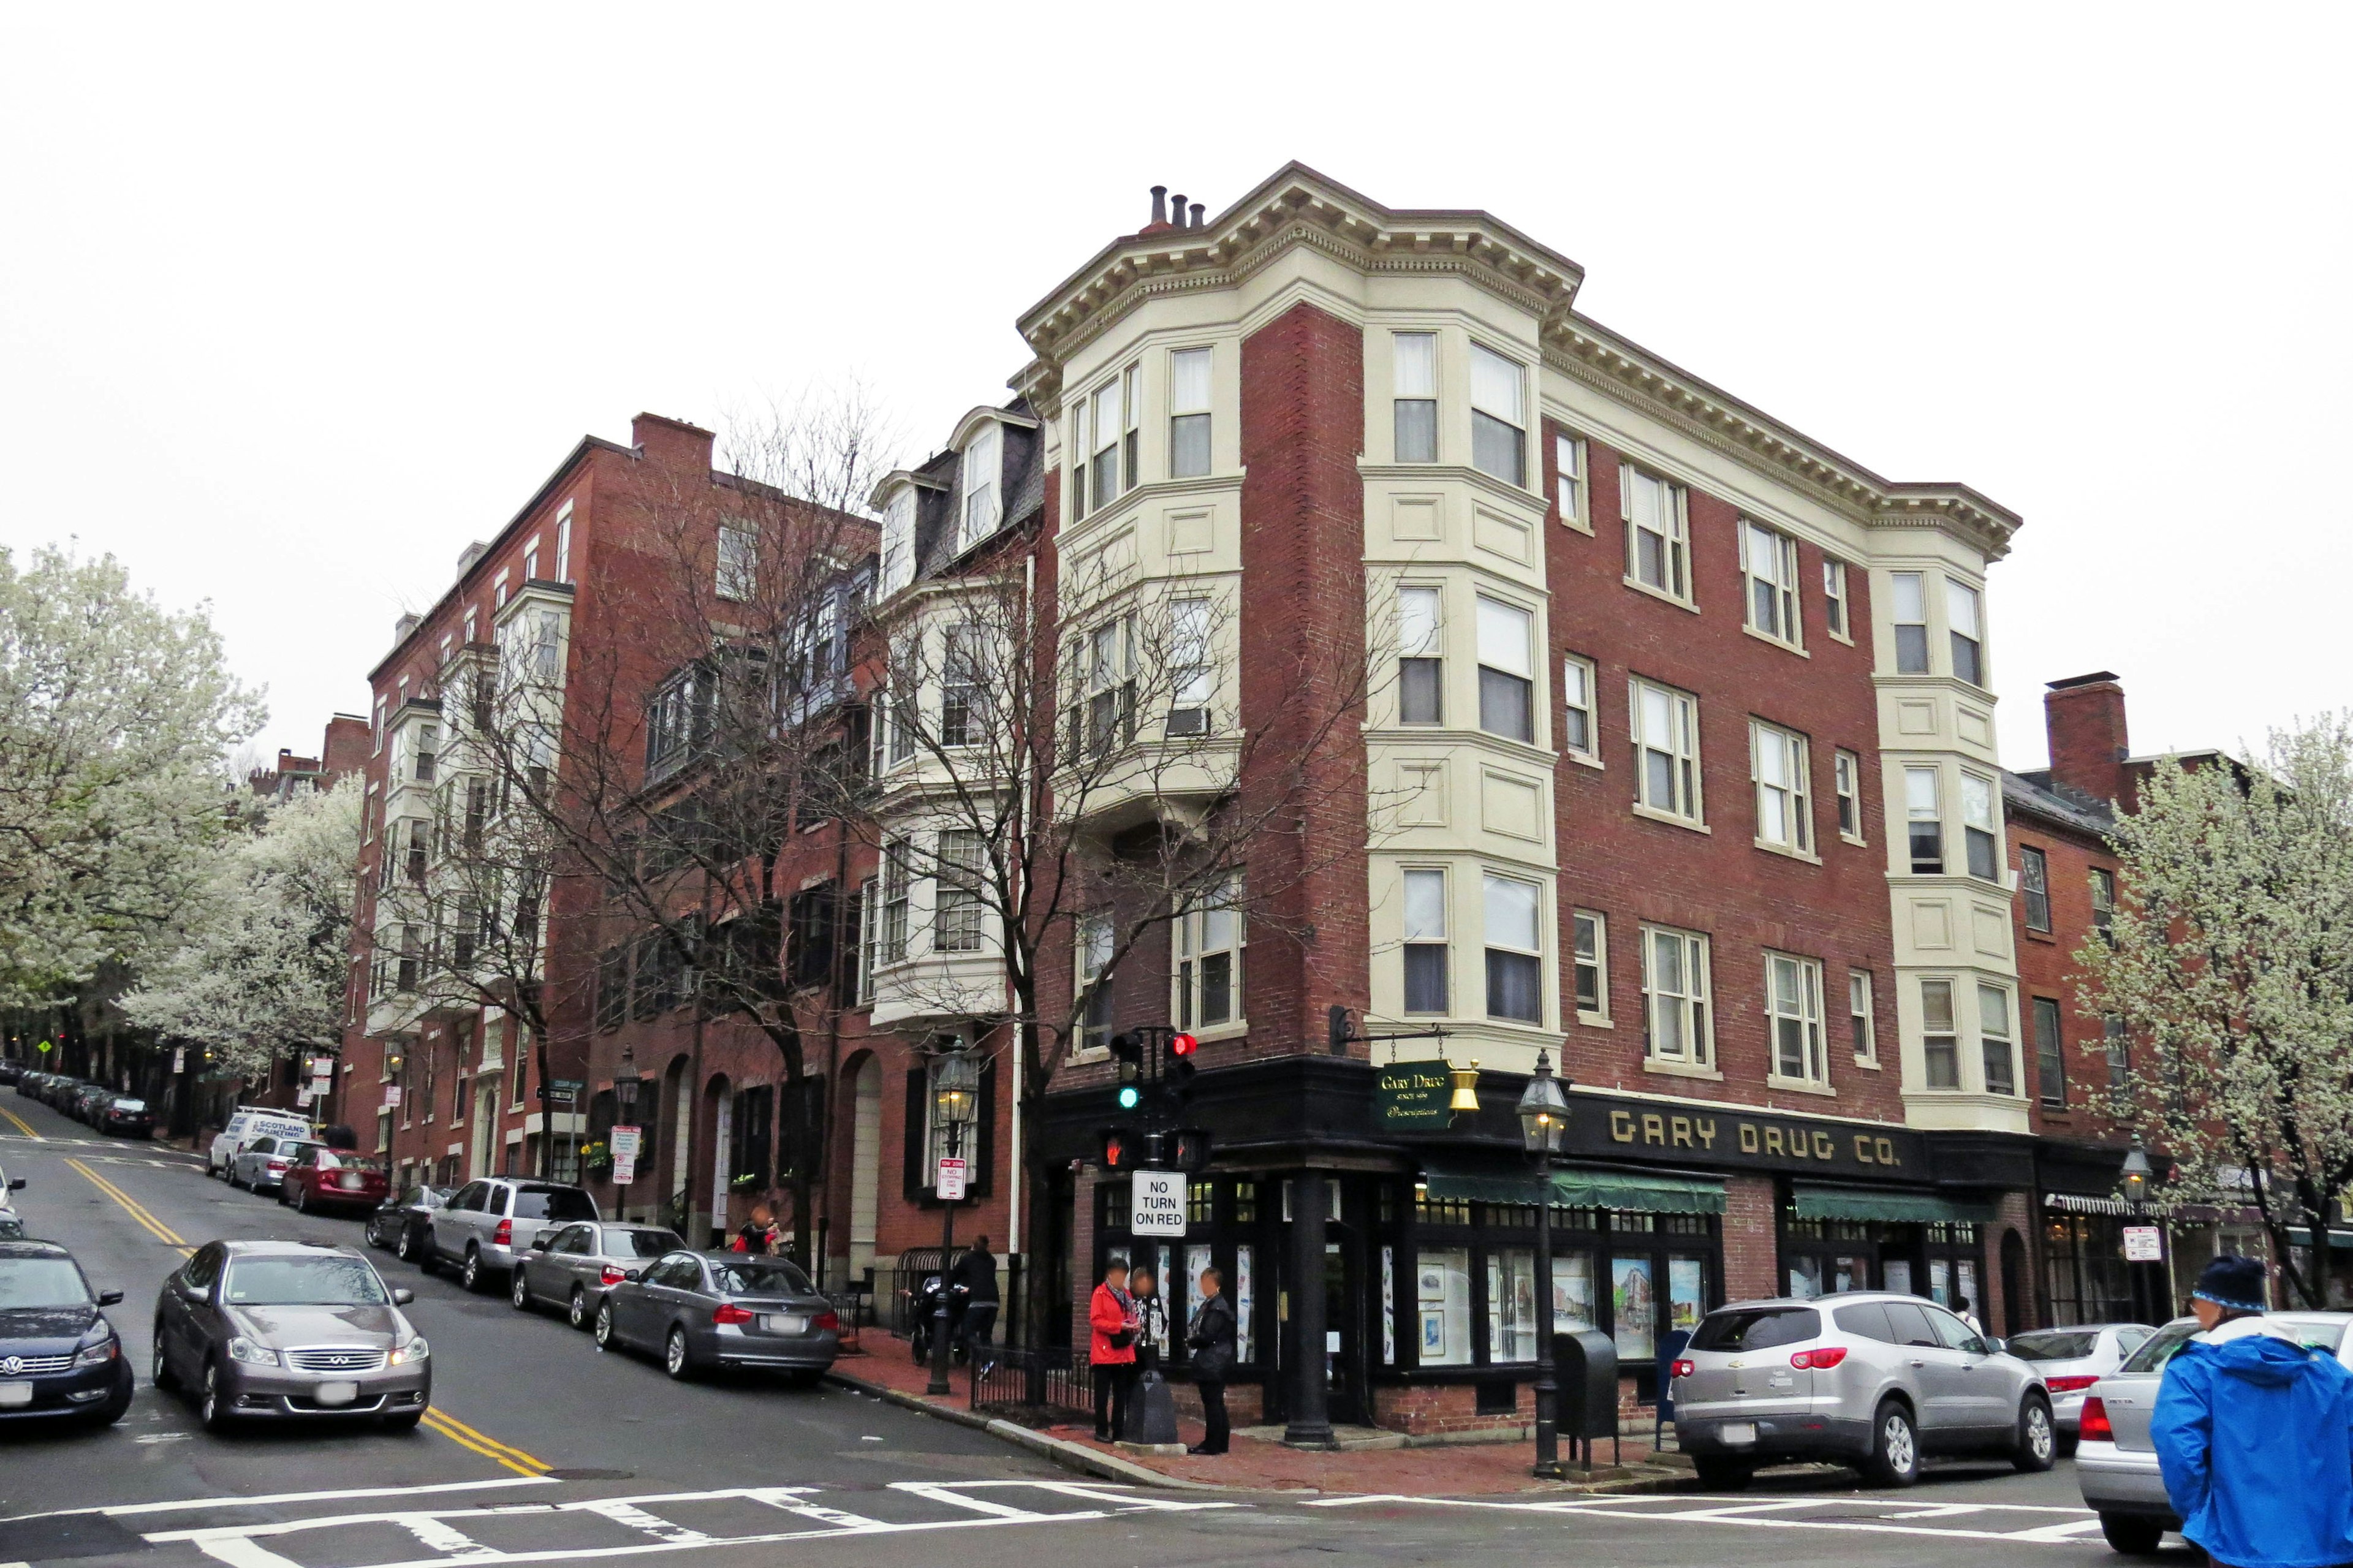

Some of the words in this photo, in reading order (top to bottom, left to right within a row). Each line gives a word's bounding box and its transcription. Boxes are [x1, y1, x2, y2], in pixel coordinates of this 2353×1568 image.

[1382, 1076, 1409, 1089] GARY
[1412, 1074, 1444, 1088] DRUG
[258, 1127, 300, 1138] PAINTING
[260, 1120, 305, 1133] SCOTLAND
[1610, 1110, 1716, 1150] GARY
[1738, 1123, 1835, 1161] DRUG
[1853, 1135, 1901, 1167] CO.
[1150, 1181, 1168, 1193] NO
[1143, 1197, 1176, 1210] TURN
[1136, 1213, 1154, 1224] ON
[1158, 1213, 1182, 1225] RED
